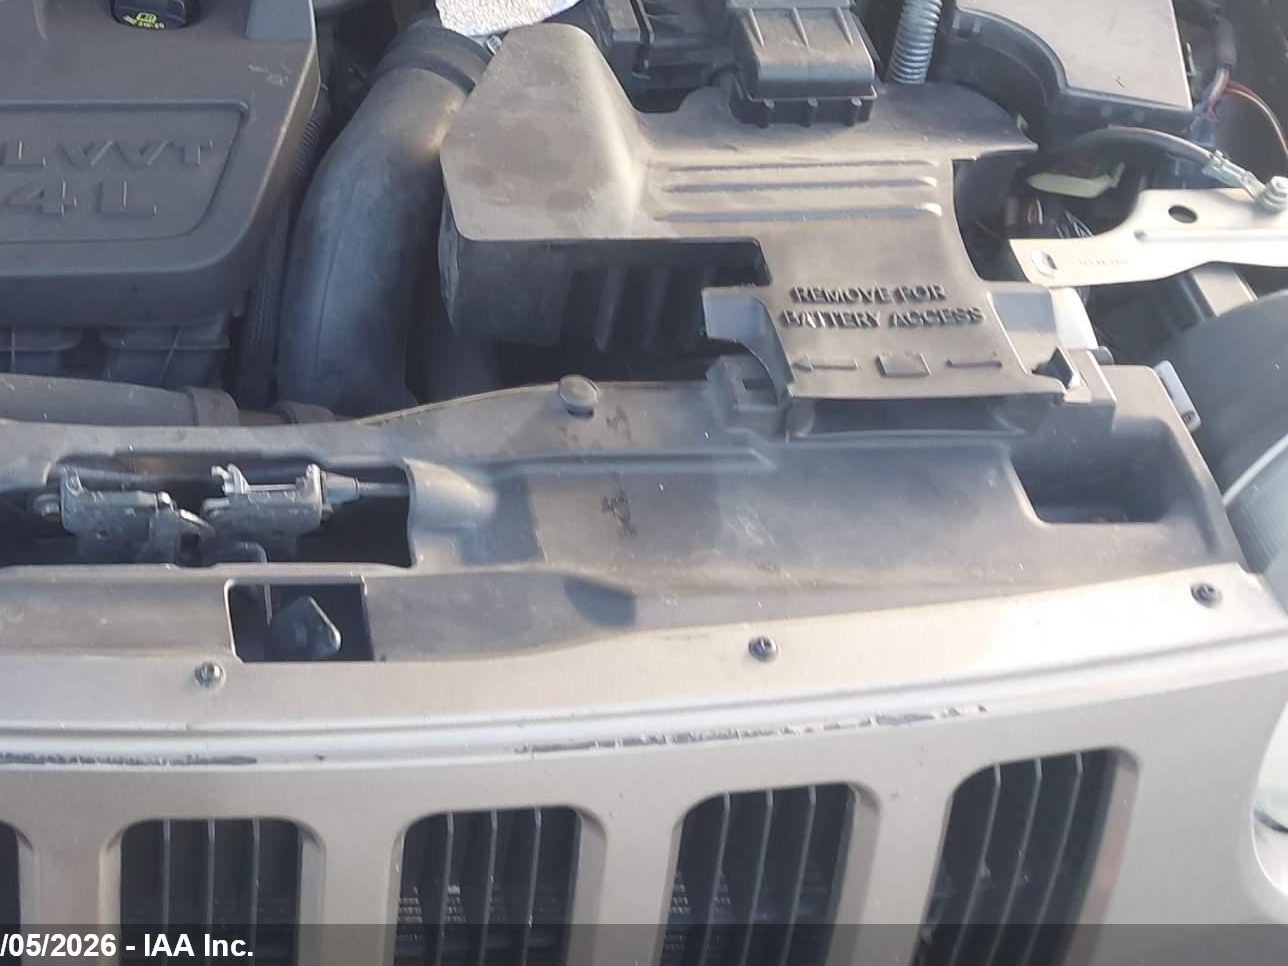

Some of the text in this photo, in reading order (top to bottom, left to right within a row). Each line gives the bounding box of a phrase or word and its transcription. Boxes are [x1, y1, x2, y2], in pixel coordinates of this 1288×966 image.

[62, 139, 214, 168] VVT
[790, 284, 948, 305] REMOVE FOR
[779, 306, 985, 329] BATTERY ACCESS
